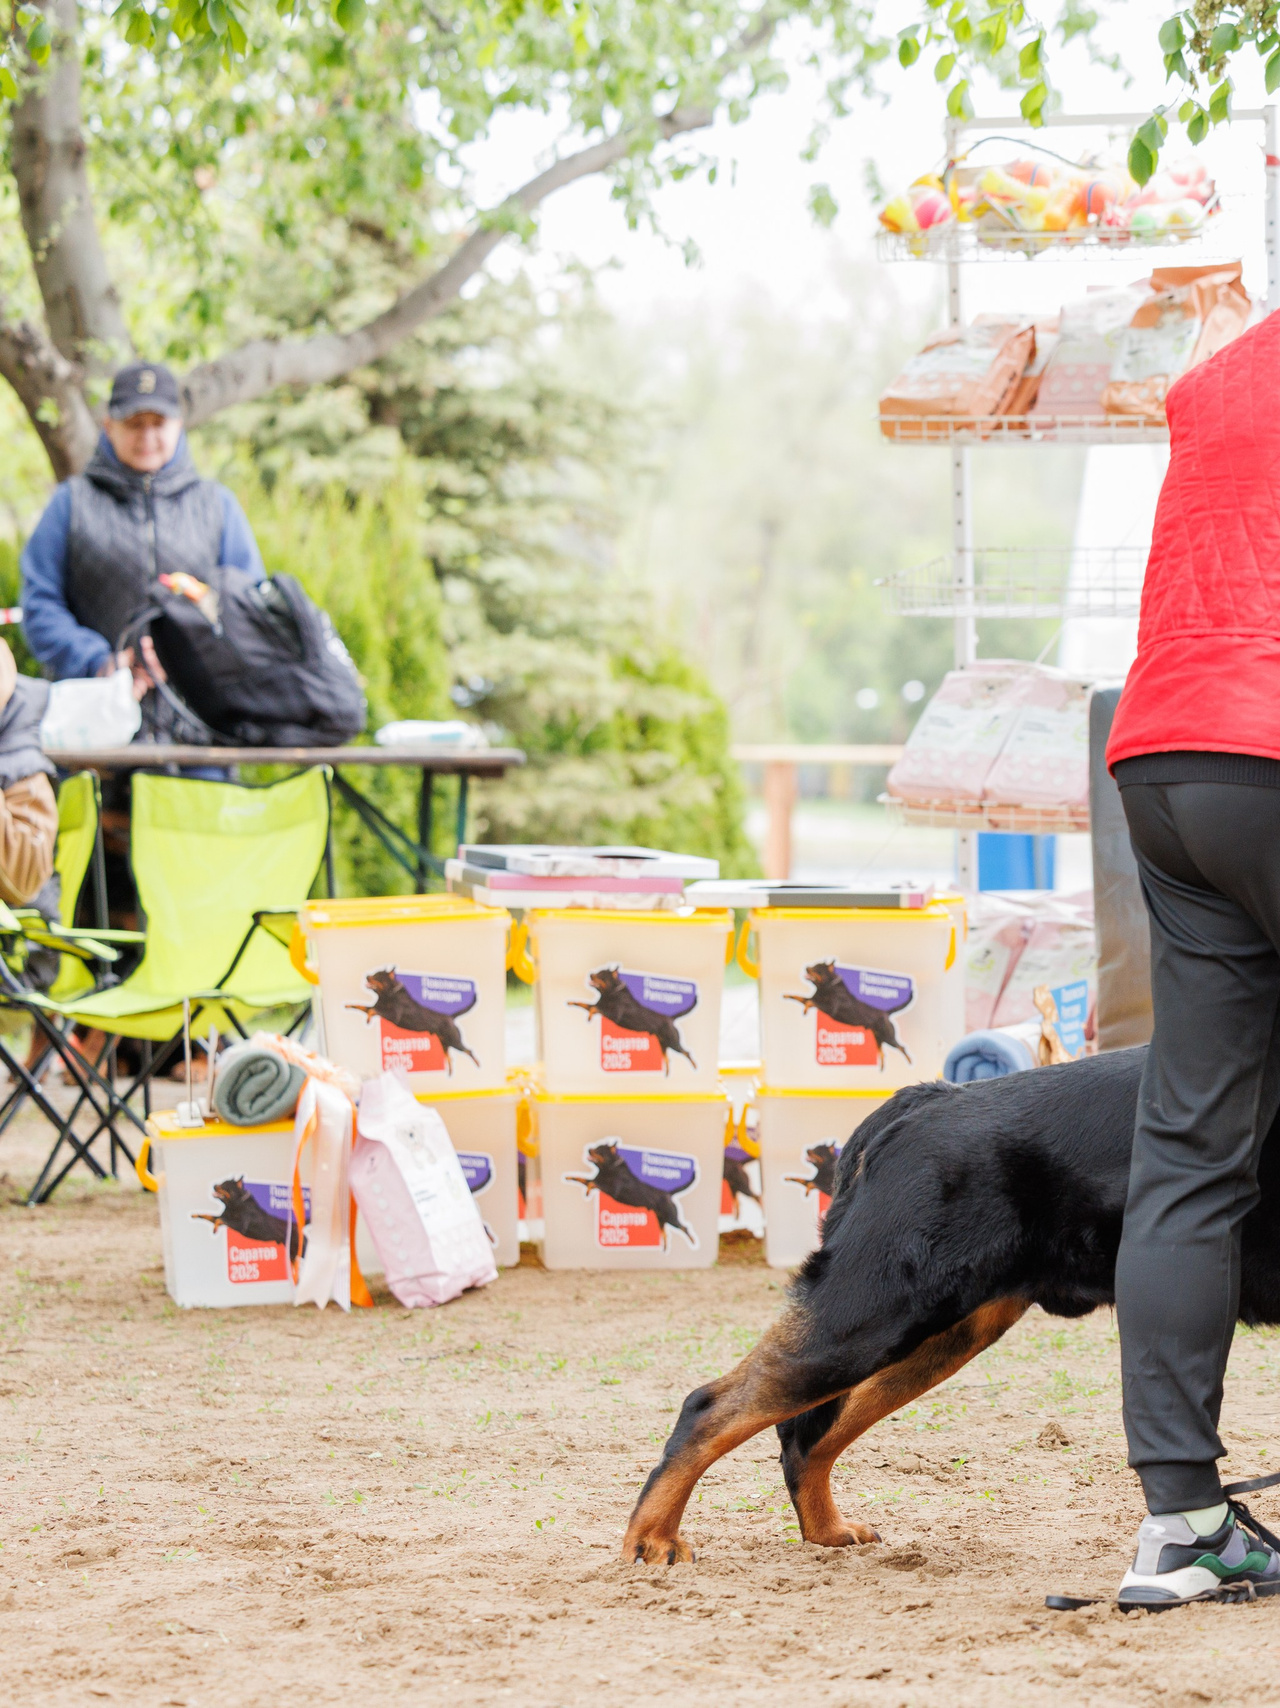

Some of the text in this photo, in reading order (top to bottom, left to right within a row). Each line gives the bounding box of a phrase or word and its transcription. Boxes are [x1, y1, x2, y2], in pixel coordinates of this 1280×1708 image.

[383, 1036, 431, 1053] Саратов
[602, 1035, 650, 1052] Саратов
[818, 1029, 865, 1046] Саратов
[384, 1054, 413, 1070] 2025
[602, 1053, 632, 1069] 2025
[818, 1046, 847, 1063] 2025
[600, 1210, 647, 1227] Саратов
[600, 1227, 629, 1244] 2025
[230, 1246, 277, 1263] Саратов
[230, 1263, 259, 1281] 2025
